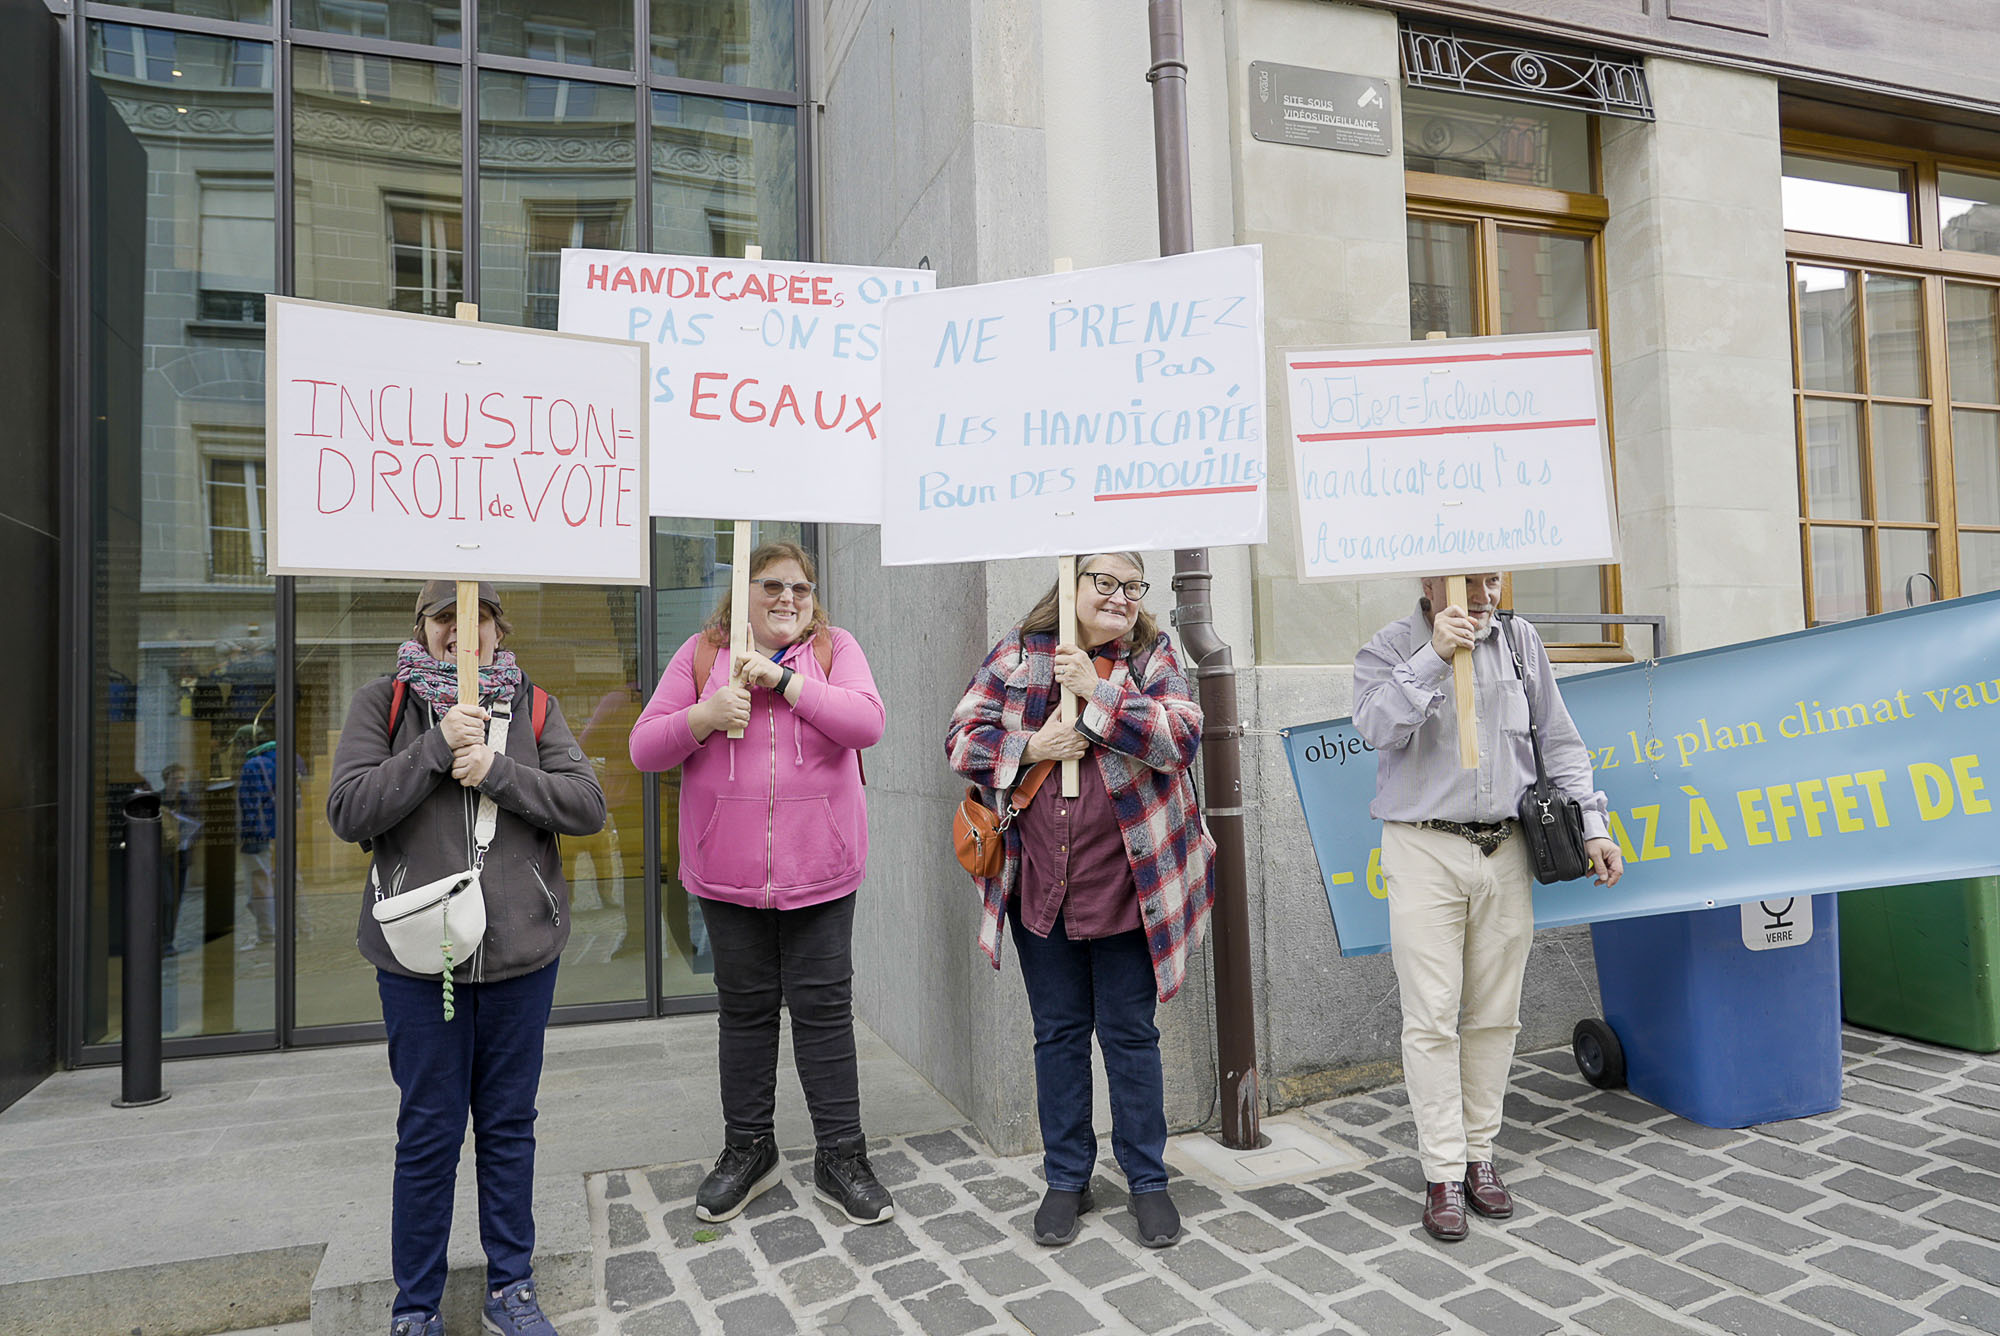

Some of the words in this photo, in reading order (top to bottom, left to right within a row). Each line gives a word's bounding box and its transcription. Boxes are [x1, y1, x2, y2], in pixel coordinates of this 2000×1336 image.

[1283, 94, 1303, 104] SITE
[1308, 97, 1333, 109] SOUS
[1283, 108, 1378, 129] VIDÉOSURVEILLANCE
[628, 307, 714, 346] PAS
[762, 308, 819, 350] ON
[933, 315, 1005, 369] NE
[1048, 295, 1249, 353] PRENEZ
[689, 372, 882, 440] EGAUX
[933, 411, 998, 447] LES
[317, 447, 495, 522] DROIT
[488, 494, 516, 519] de
[512, 457, 637, 528] VOTE
[1010, 467, 1077, 500] DES
[1627, 730, 1665, 765] le
[1674, 717, 1768, 768] plan
[1778, 688, 1915, 739] climat
[1680, 785, 1728, 854] À
[1737, 769, 1890, 846] EFFET
[1908, 754, 1992, 821] DE
[1766, 930, 1793, 943] VERRE
